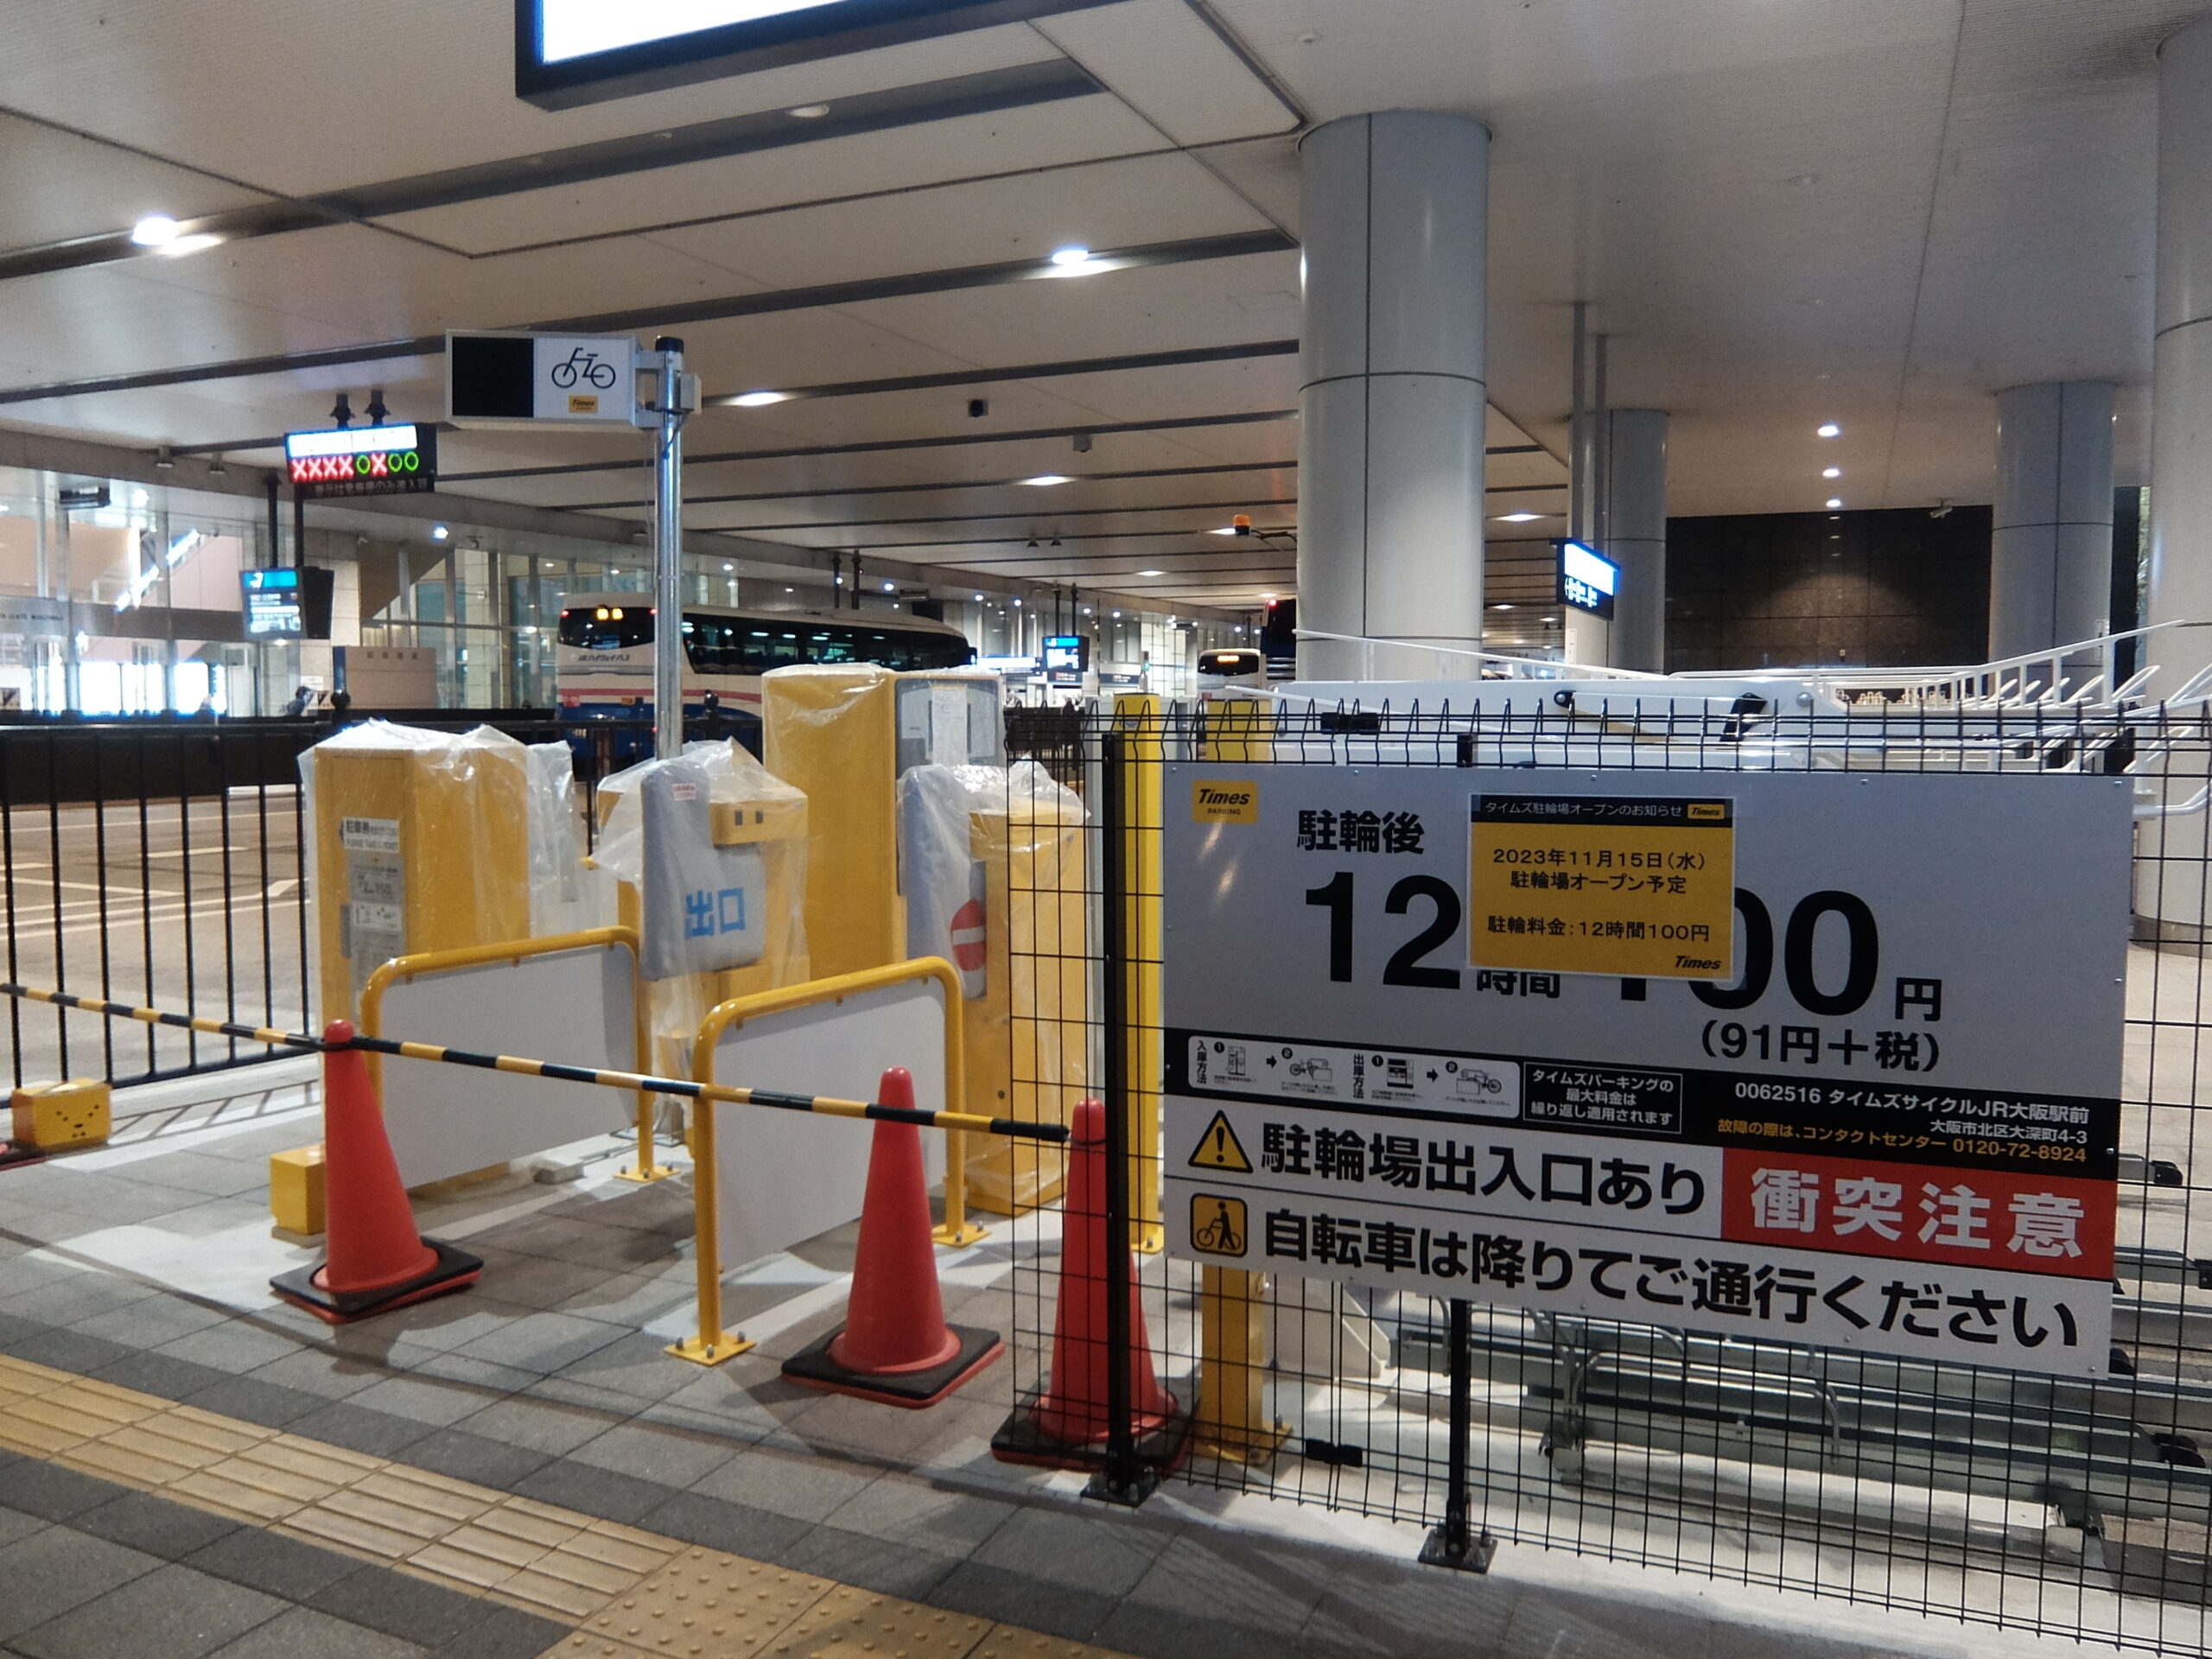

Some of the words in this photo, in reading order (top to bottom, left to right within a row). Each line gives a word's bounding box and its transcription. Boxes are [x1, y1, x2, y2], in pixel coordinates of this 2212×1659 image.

[1198, 788, 1250, 805] Times
[1485, 802, 1682, 817] タイムズ駐輪場オープンのお知らせ
[1691, 807, 1721, 817] Times
[1297, 809, 1425, 855] 駐輪後
[1510, 870, 1687, 893] 駐輪場オープン予定
[684, 887, 746, 939] 出口
[1674, 956, 1721, 969] Times
[1197, 1039, 1207, 1084] 入庫方法
[1353, 1053, 1363, 1099] 出庫方法
[1533, 1069, 1674, 1092] タイムズパーキングの
[1531, 1101, 1673, 1125] 繰り返し適用されます
[1567, 1088, 1637, 1106] 最大料金は
[1735, 1082, 1821, 1104] 0062516
[1828, 1089, 2089, 1124] タイムズサイクルJR大阪駅前
[1718, 1119, 1947, 1149] 故障の際は、コンタクトセンター
[1953, 1138, 2088, 1162] 0120-72-8924
[1930, 1119, 2088, 1144] 大阪市北区大深町4-3
[1262, 1123, 1706, 1215] 駐輪場出入口あり
[1751, 1167, 2084, 1258] 衝突注意
[1265, 1209, 2078, 1348] 自転車は降りてご通行ください
